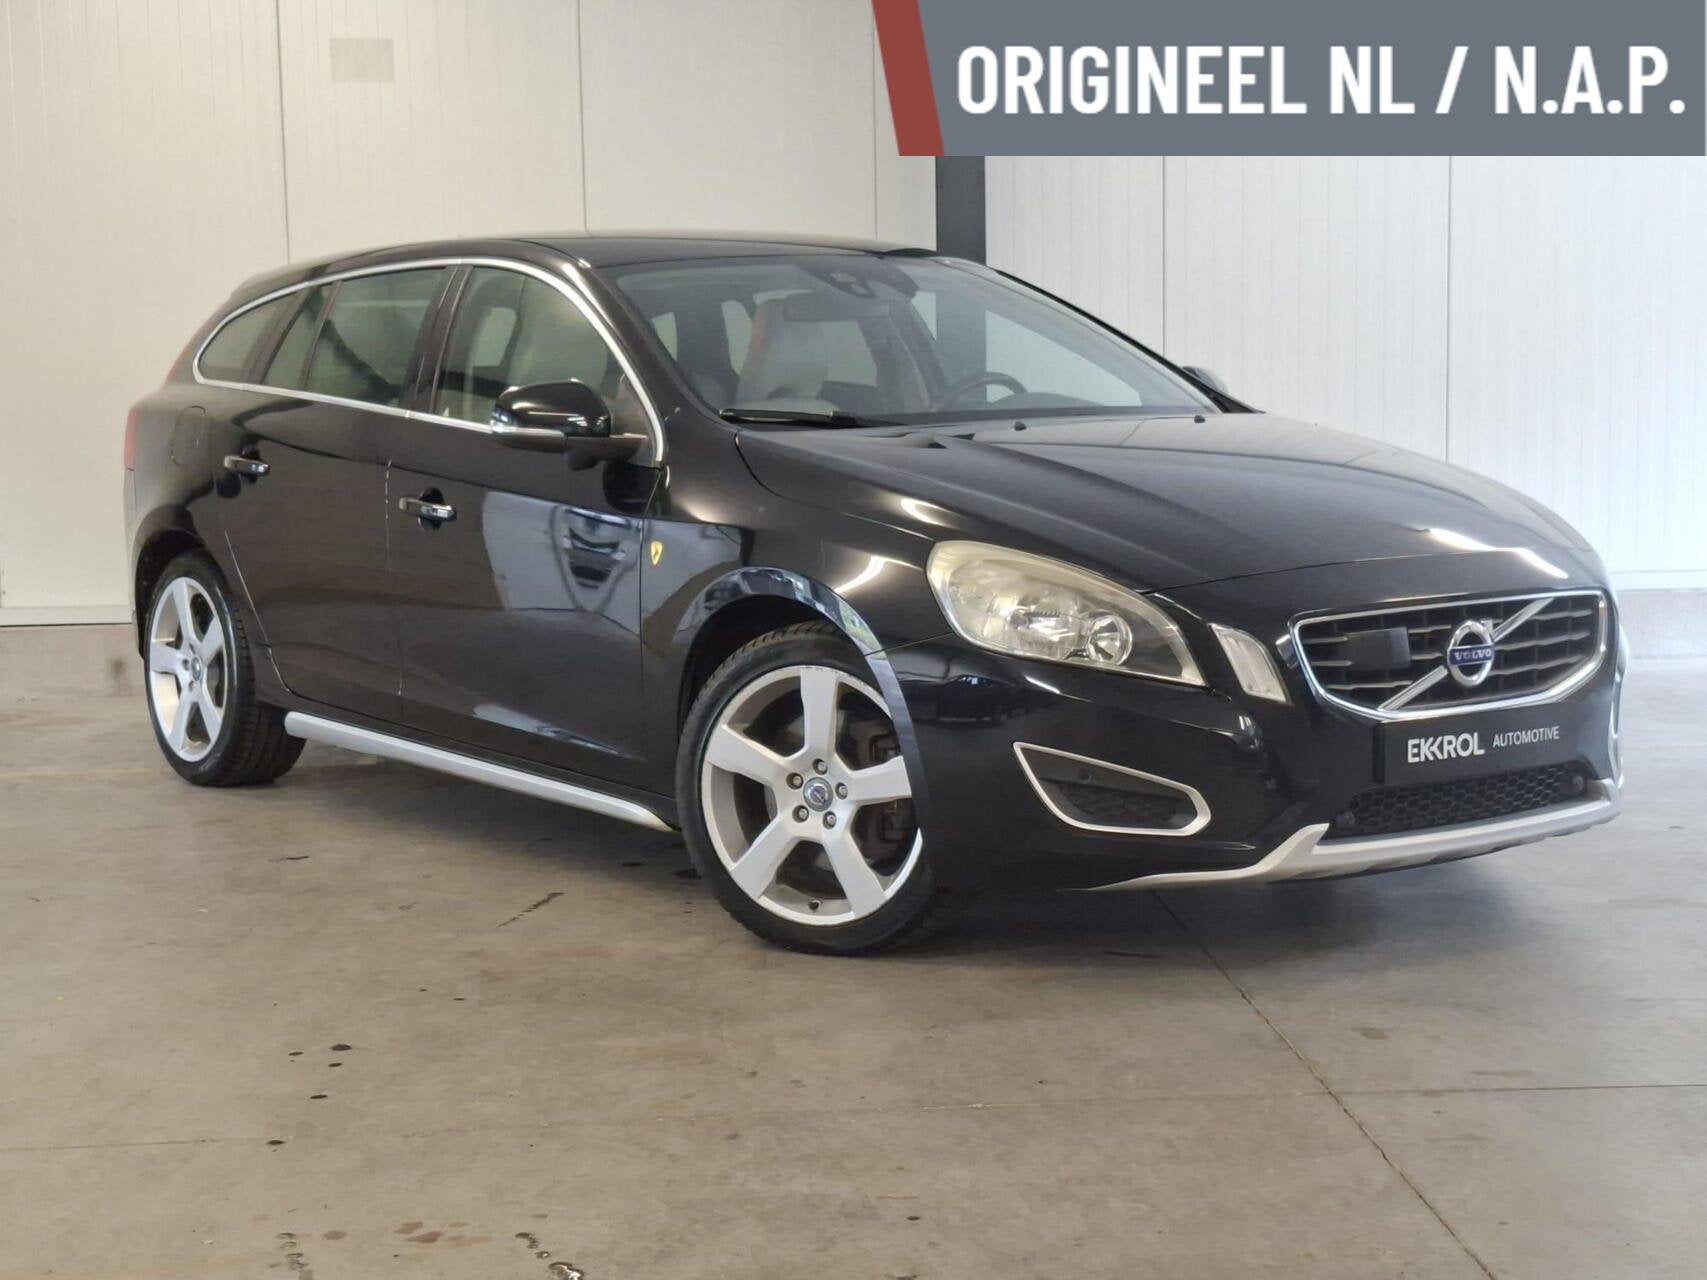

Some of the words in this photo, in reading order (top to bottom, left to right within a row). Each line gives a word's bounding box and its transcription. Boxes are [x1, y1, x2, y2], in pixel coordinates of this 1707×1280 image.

[1454, 648, 1493, 660] VOLVO
[1407, 732, 1485, 763] EKKROL
[1492, 725, 1560, 748] AUTOMOTIVE
